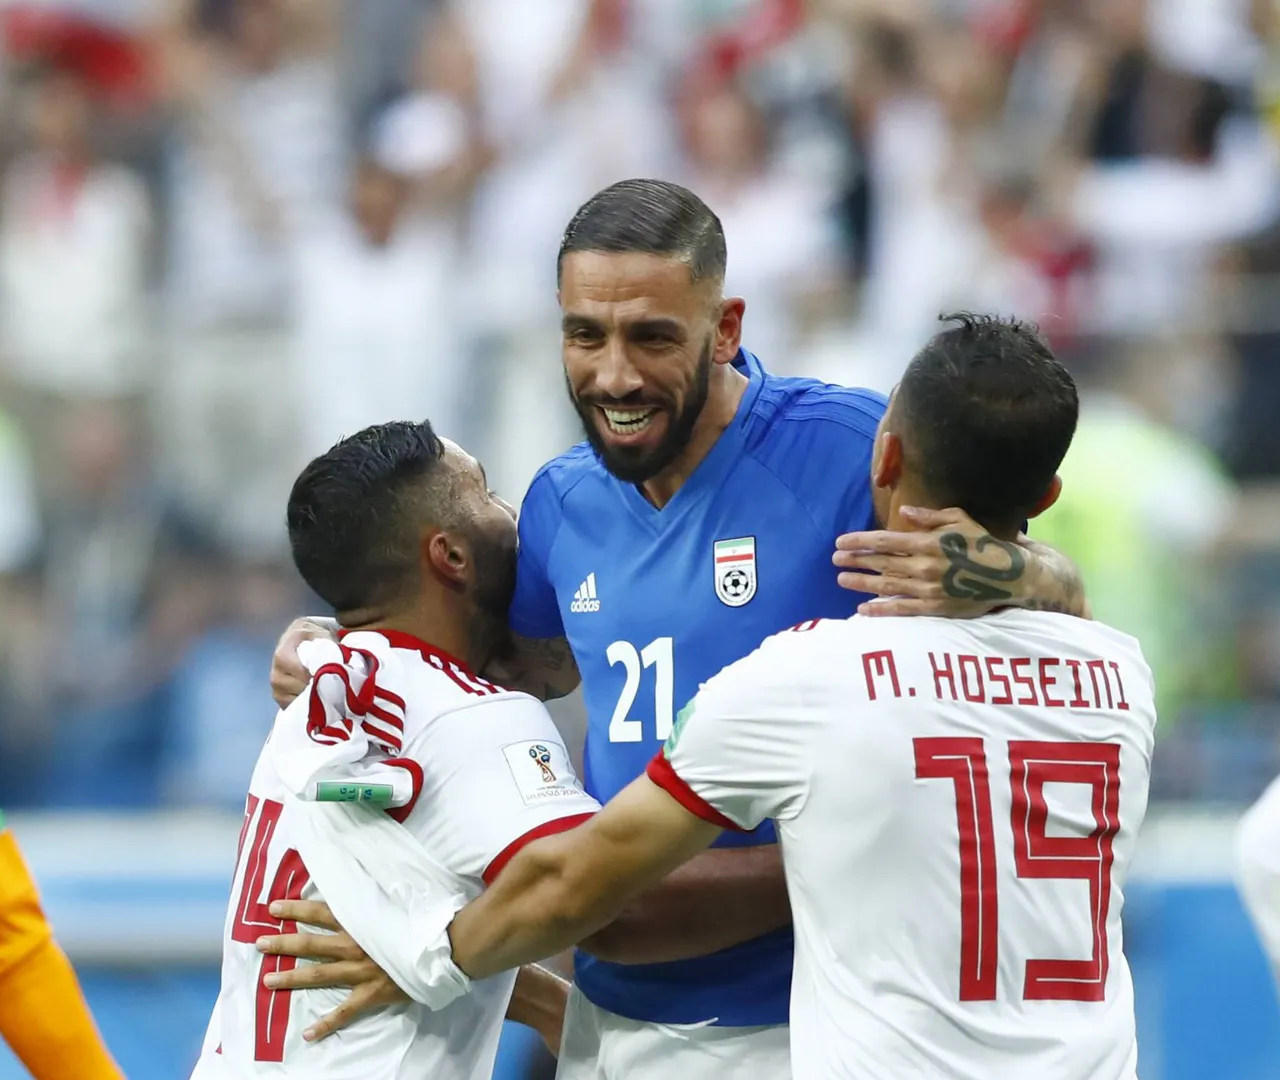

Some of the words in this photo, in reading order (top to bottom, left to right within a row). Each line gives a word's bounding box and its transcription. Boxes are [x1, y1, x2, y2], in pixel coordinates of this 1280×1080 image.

[571, 599, 600, 612] adidas
[606, 637, 674, 743] 21
[862, 650, 916, 701] M.
[928, 652, 1130, 710] HOSSEINI
[912, 737, 1121, 1002] 19
